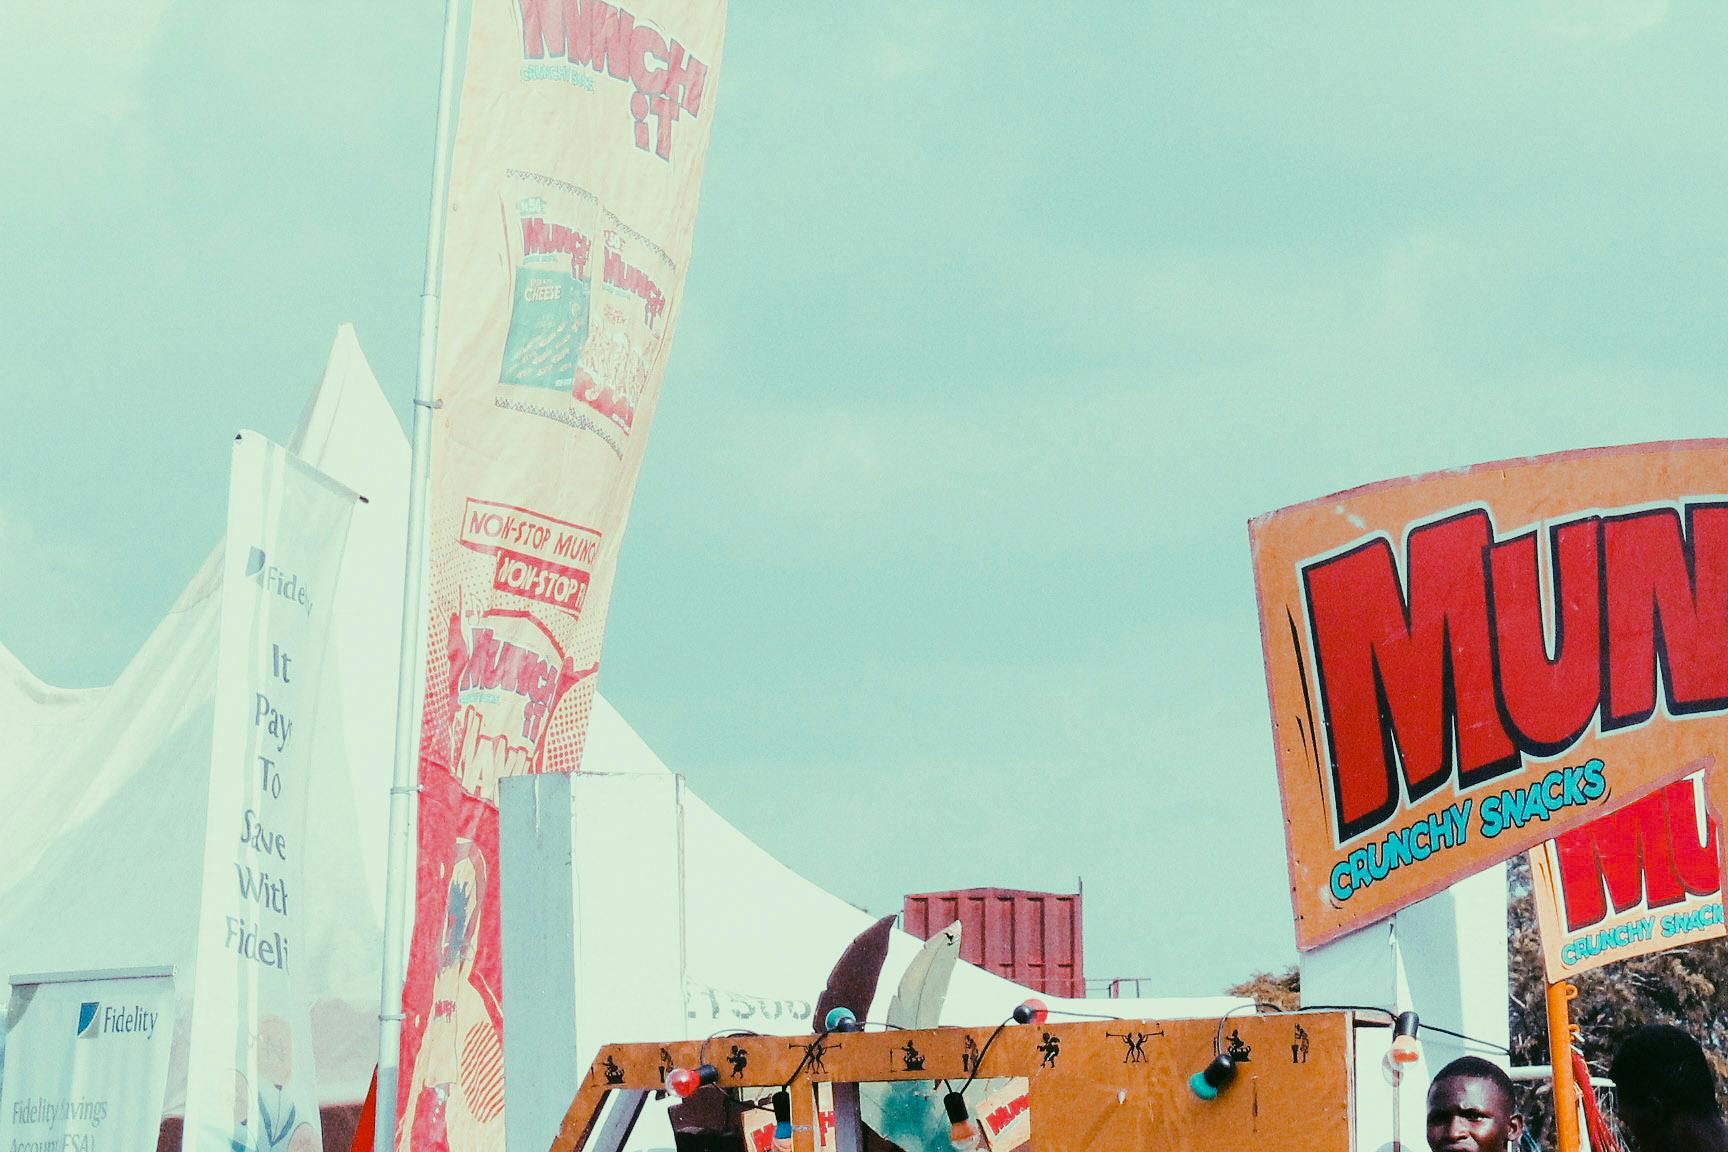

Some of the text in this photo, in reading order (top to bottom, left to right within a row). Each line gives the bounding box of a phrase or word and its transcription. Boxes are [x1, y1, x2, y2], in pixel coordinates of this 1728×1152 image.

[469, 511, 598, 565] NON-STOP MUNC
[499, 557, 578, 602] NON-STOP
[273, 643, 292, 683] It
[254, 692, 292, 753] Pay
[258, 755, 282, 801] To
[240, 808, 288, 861] Save
[1329, 757, 1607, 902] CRUNCHY SNACKS
[225, 913, 290, 972] Fideli
[1561, 914, 1656, 966] CRUNCHY
[103, 1005, 158, 1040] Fidelity
[12, 1096, 58, 1130] Fidelity
